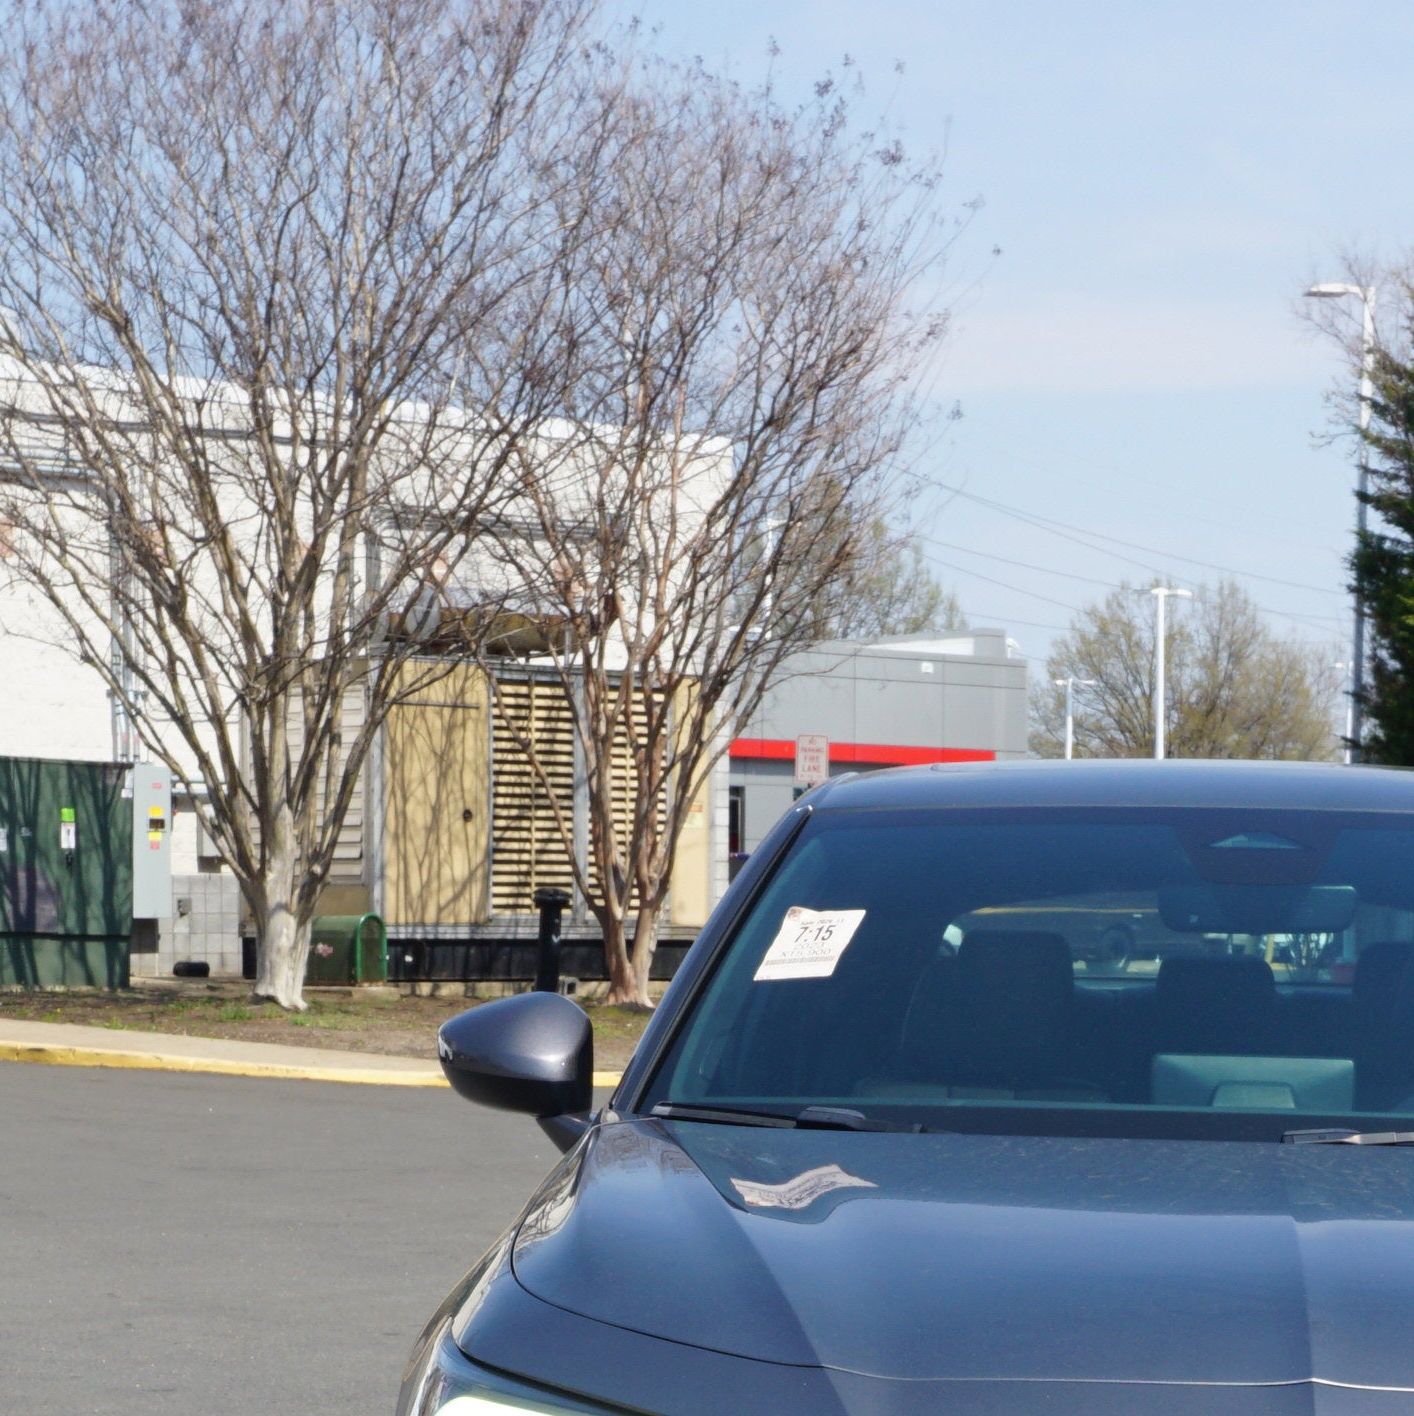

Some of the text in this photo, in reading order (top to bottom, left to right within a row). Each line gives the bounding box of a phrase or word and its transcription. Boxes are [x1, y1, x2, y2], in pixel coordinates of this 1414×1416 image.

[803, 755, 819, 763] FIRE
[802, 764, 820, 773] LANE
[794, 924, 836, 943] 7:15
